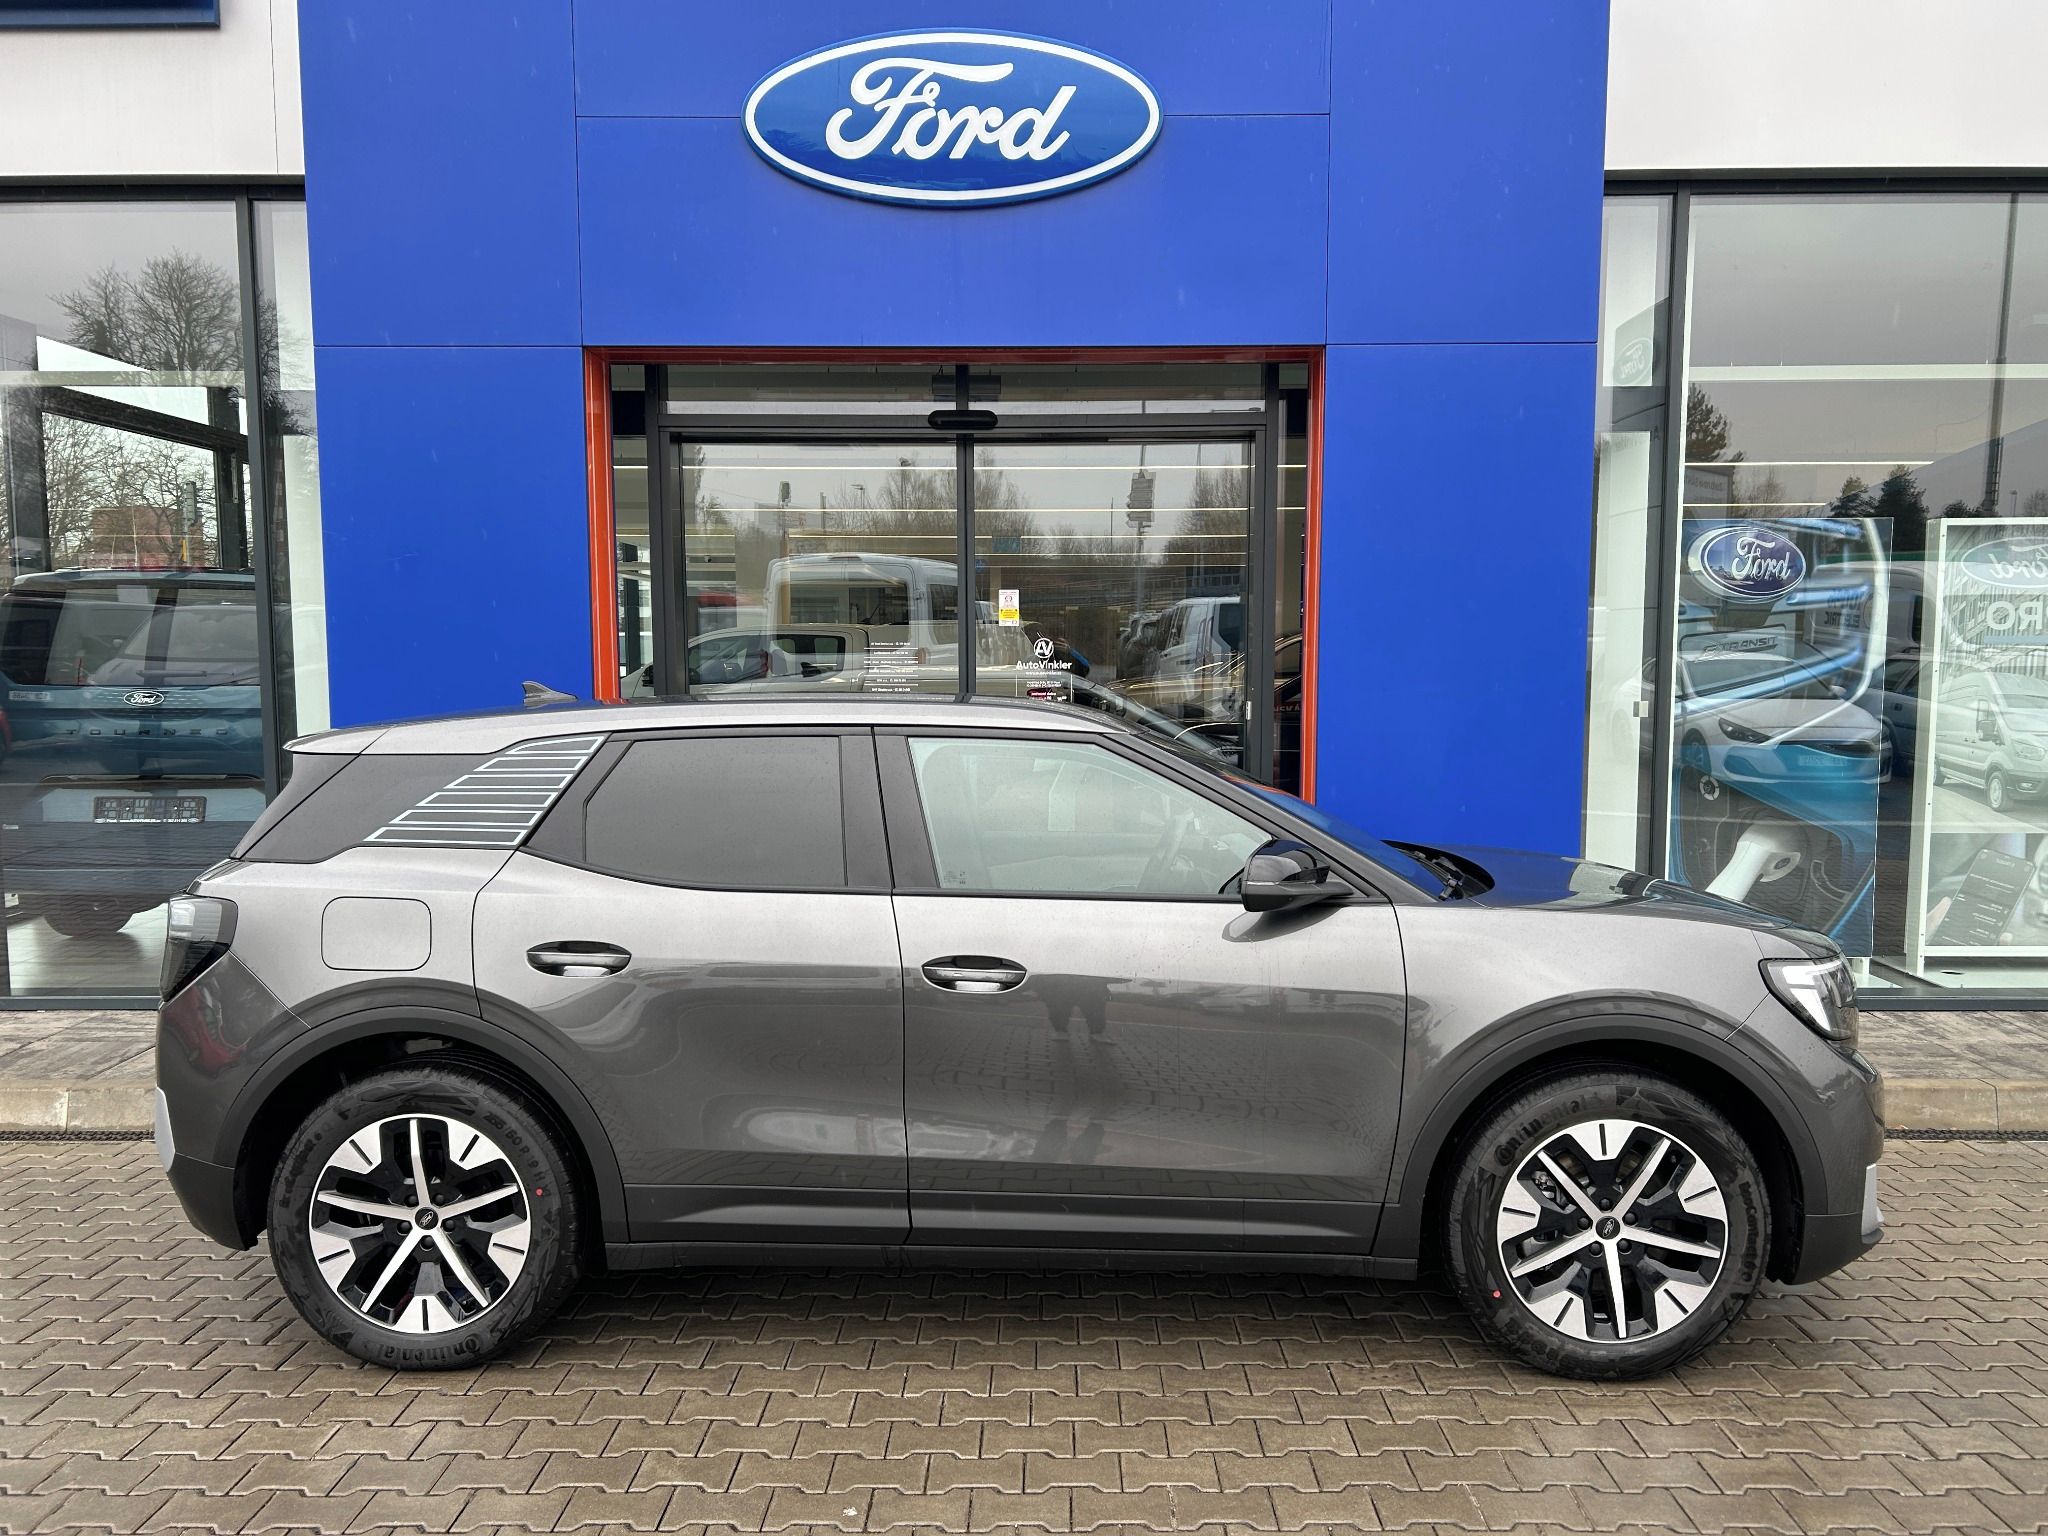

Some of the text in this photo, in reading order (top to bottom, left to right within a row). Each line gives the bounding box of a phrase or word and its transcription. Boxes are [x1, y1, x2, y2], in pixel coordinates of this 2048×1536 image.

[826, 57, 1077, 160] Ford
[1731, 536, 1791, 580] Ford
[1016, 660, 1073, 670] AutoVinkler
